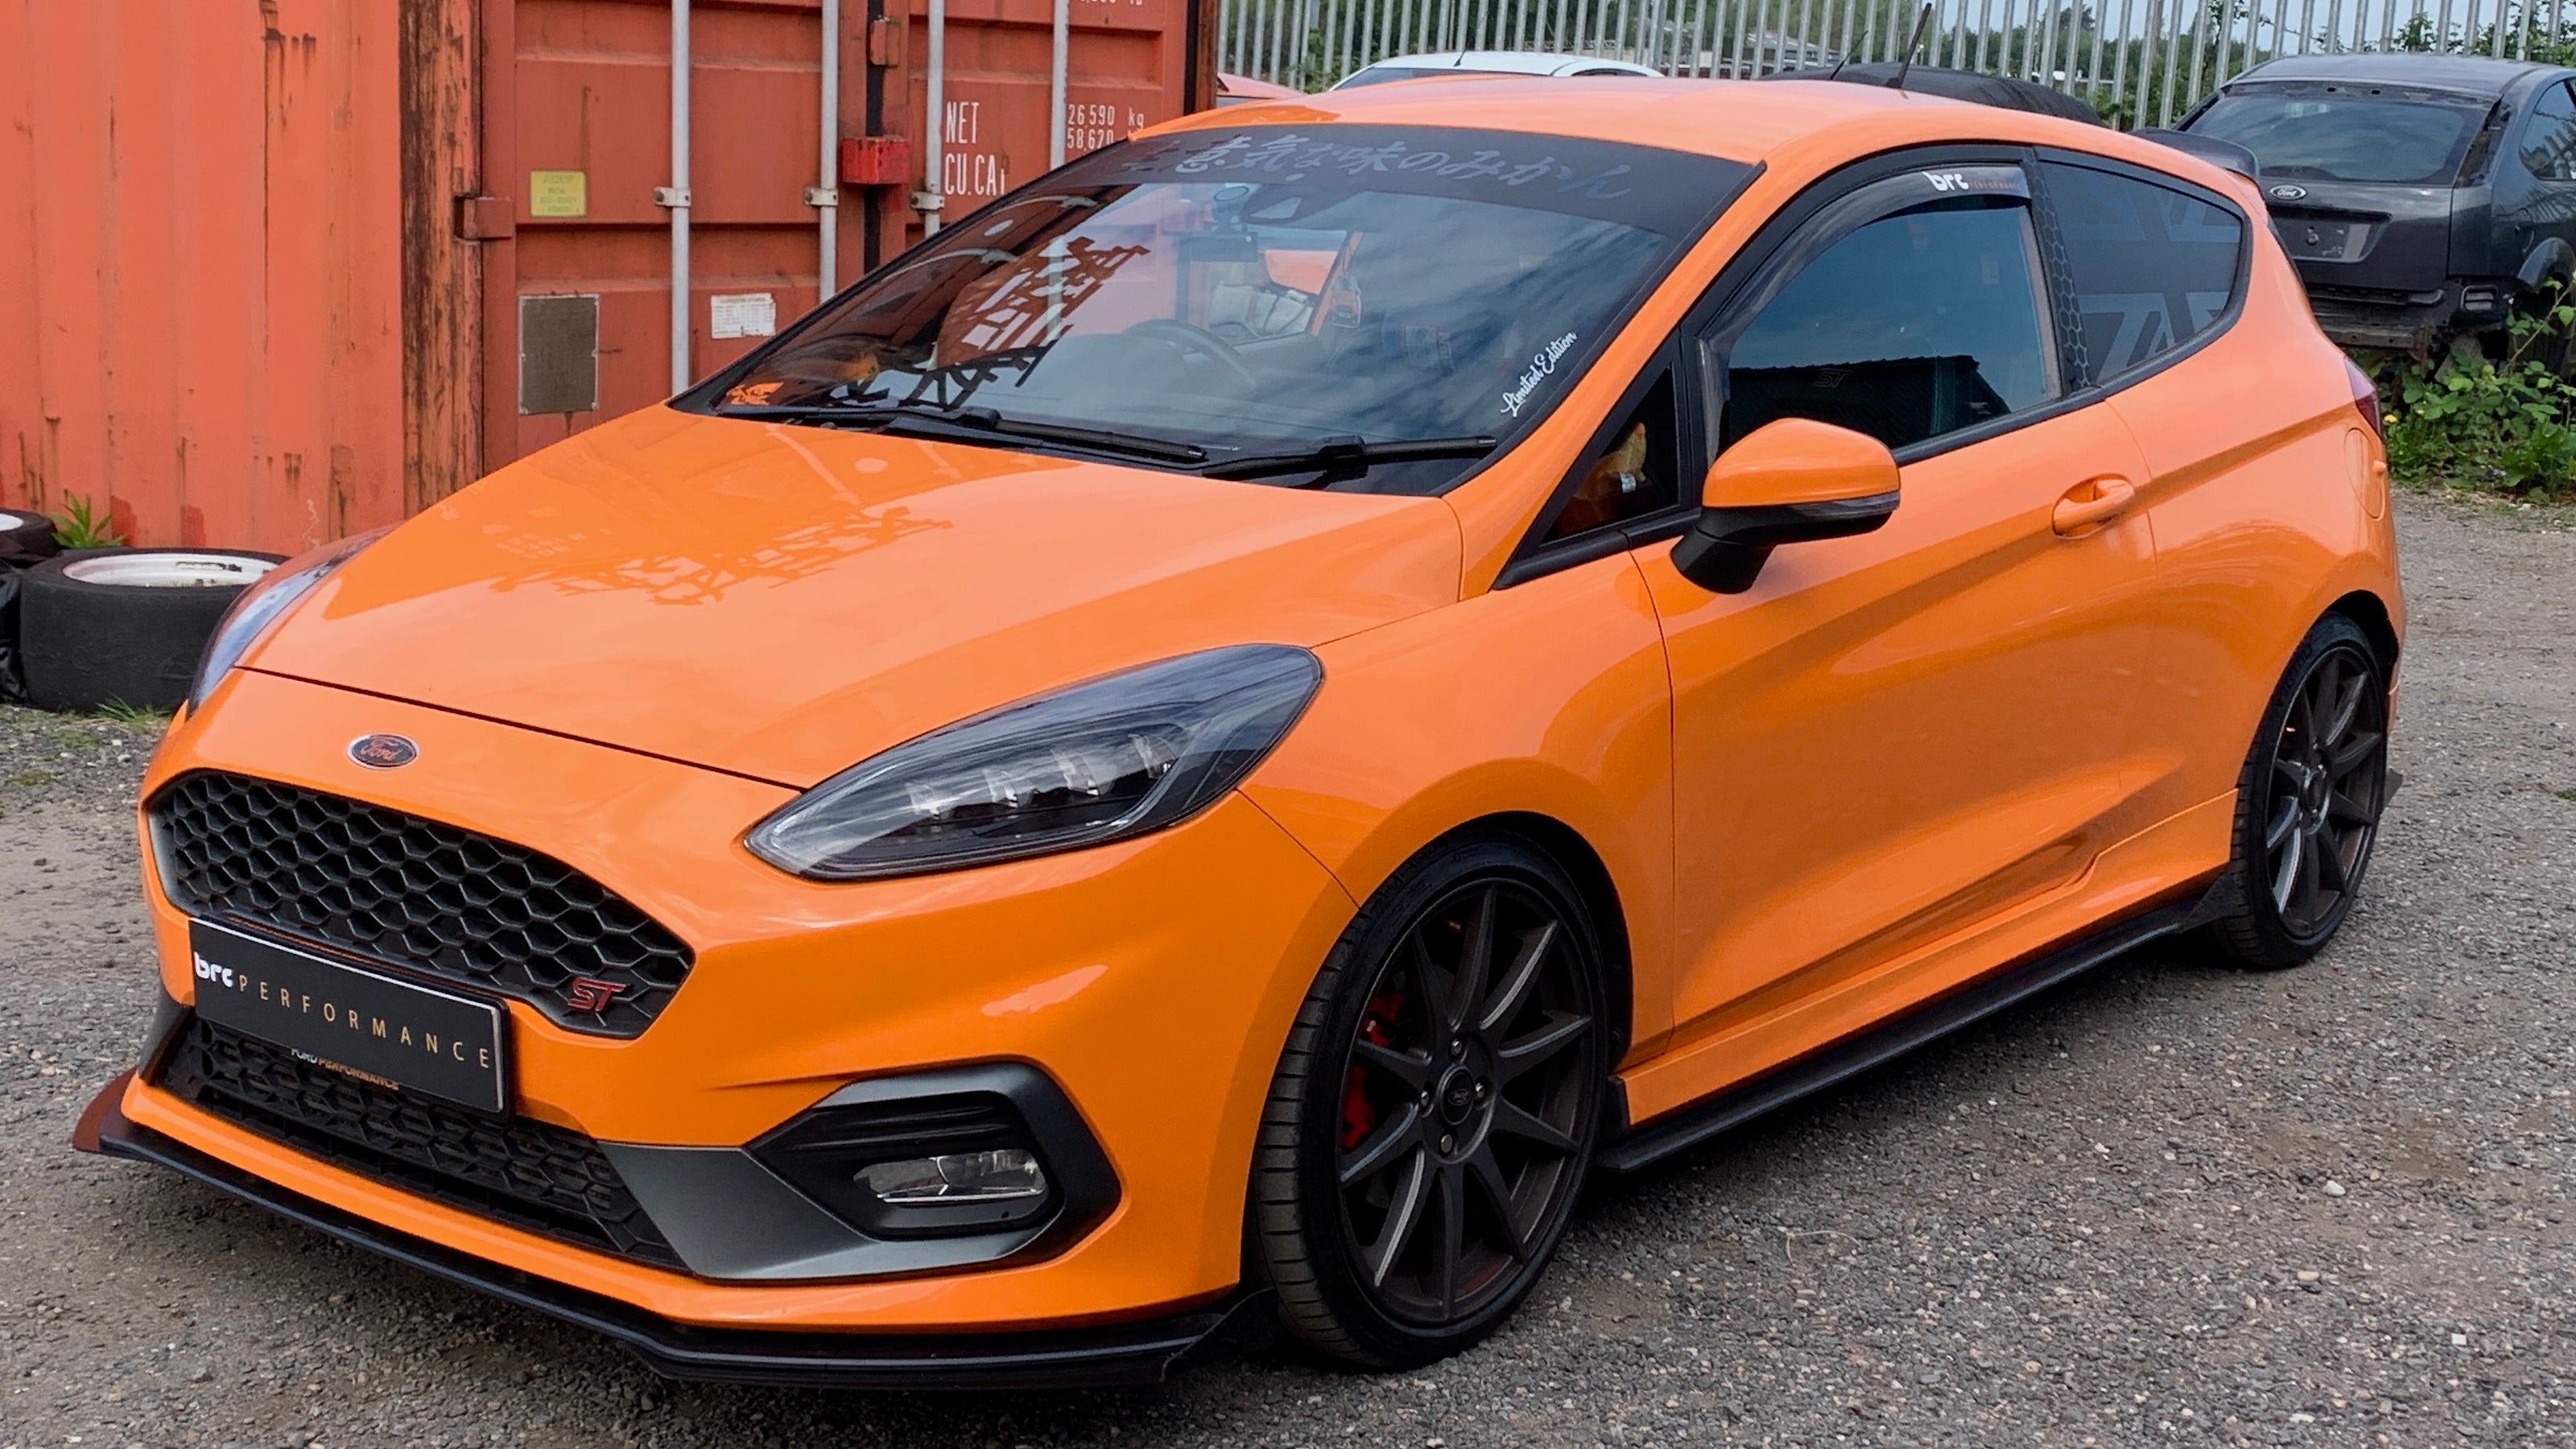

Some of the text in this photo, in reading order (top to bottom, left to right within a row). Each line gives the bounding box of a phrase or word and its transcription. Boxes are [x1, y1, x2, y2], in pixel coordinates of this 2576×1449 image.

[946, 101, 980, 143] NET
[1128, 106, 1145, 129] kg
[1500, 331, 1578, 418] Limited Edition
[193, 951, 489, 1069] brc PERFORMANCE
[567, 976, 627, 1012] ST
